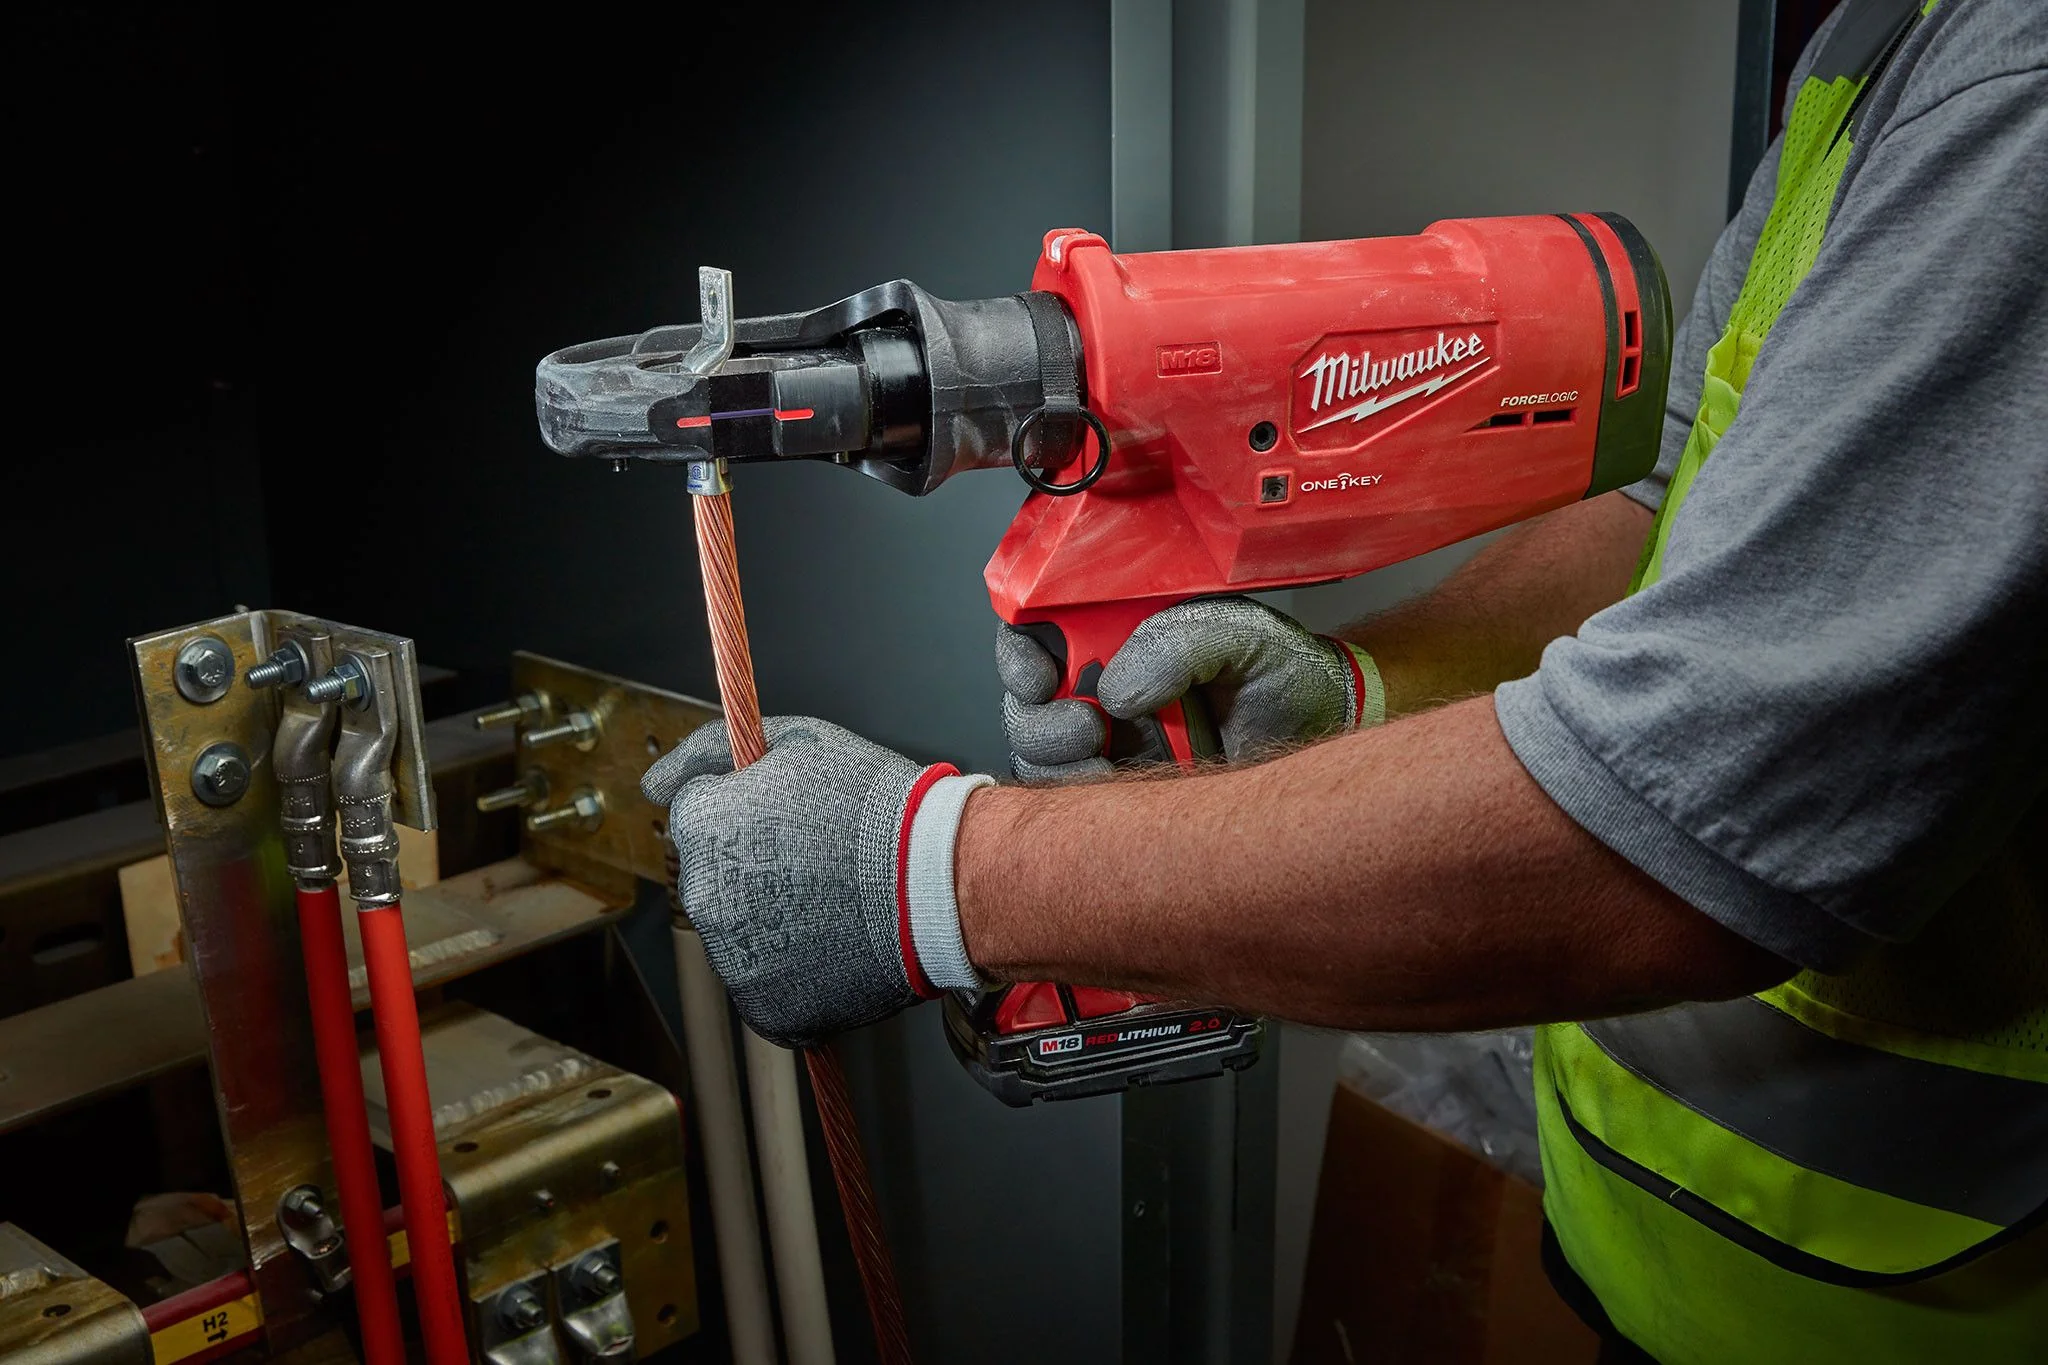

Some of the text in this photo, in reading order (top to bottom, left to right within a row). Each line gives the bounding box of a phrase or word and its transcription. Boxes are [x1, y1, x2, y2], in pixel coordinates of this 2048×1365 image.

[1161, 348, 1217, 370] M18
[1300, 332, 1485, 411] Milwaukee
[1500, 390, 1578, 407] FORCELOGIC
[1042, 1018, 1220, 1052] M18 REDLITHIUM 2.0
[202, 1311, 228, 1332] H2
